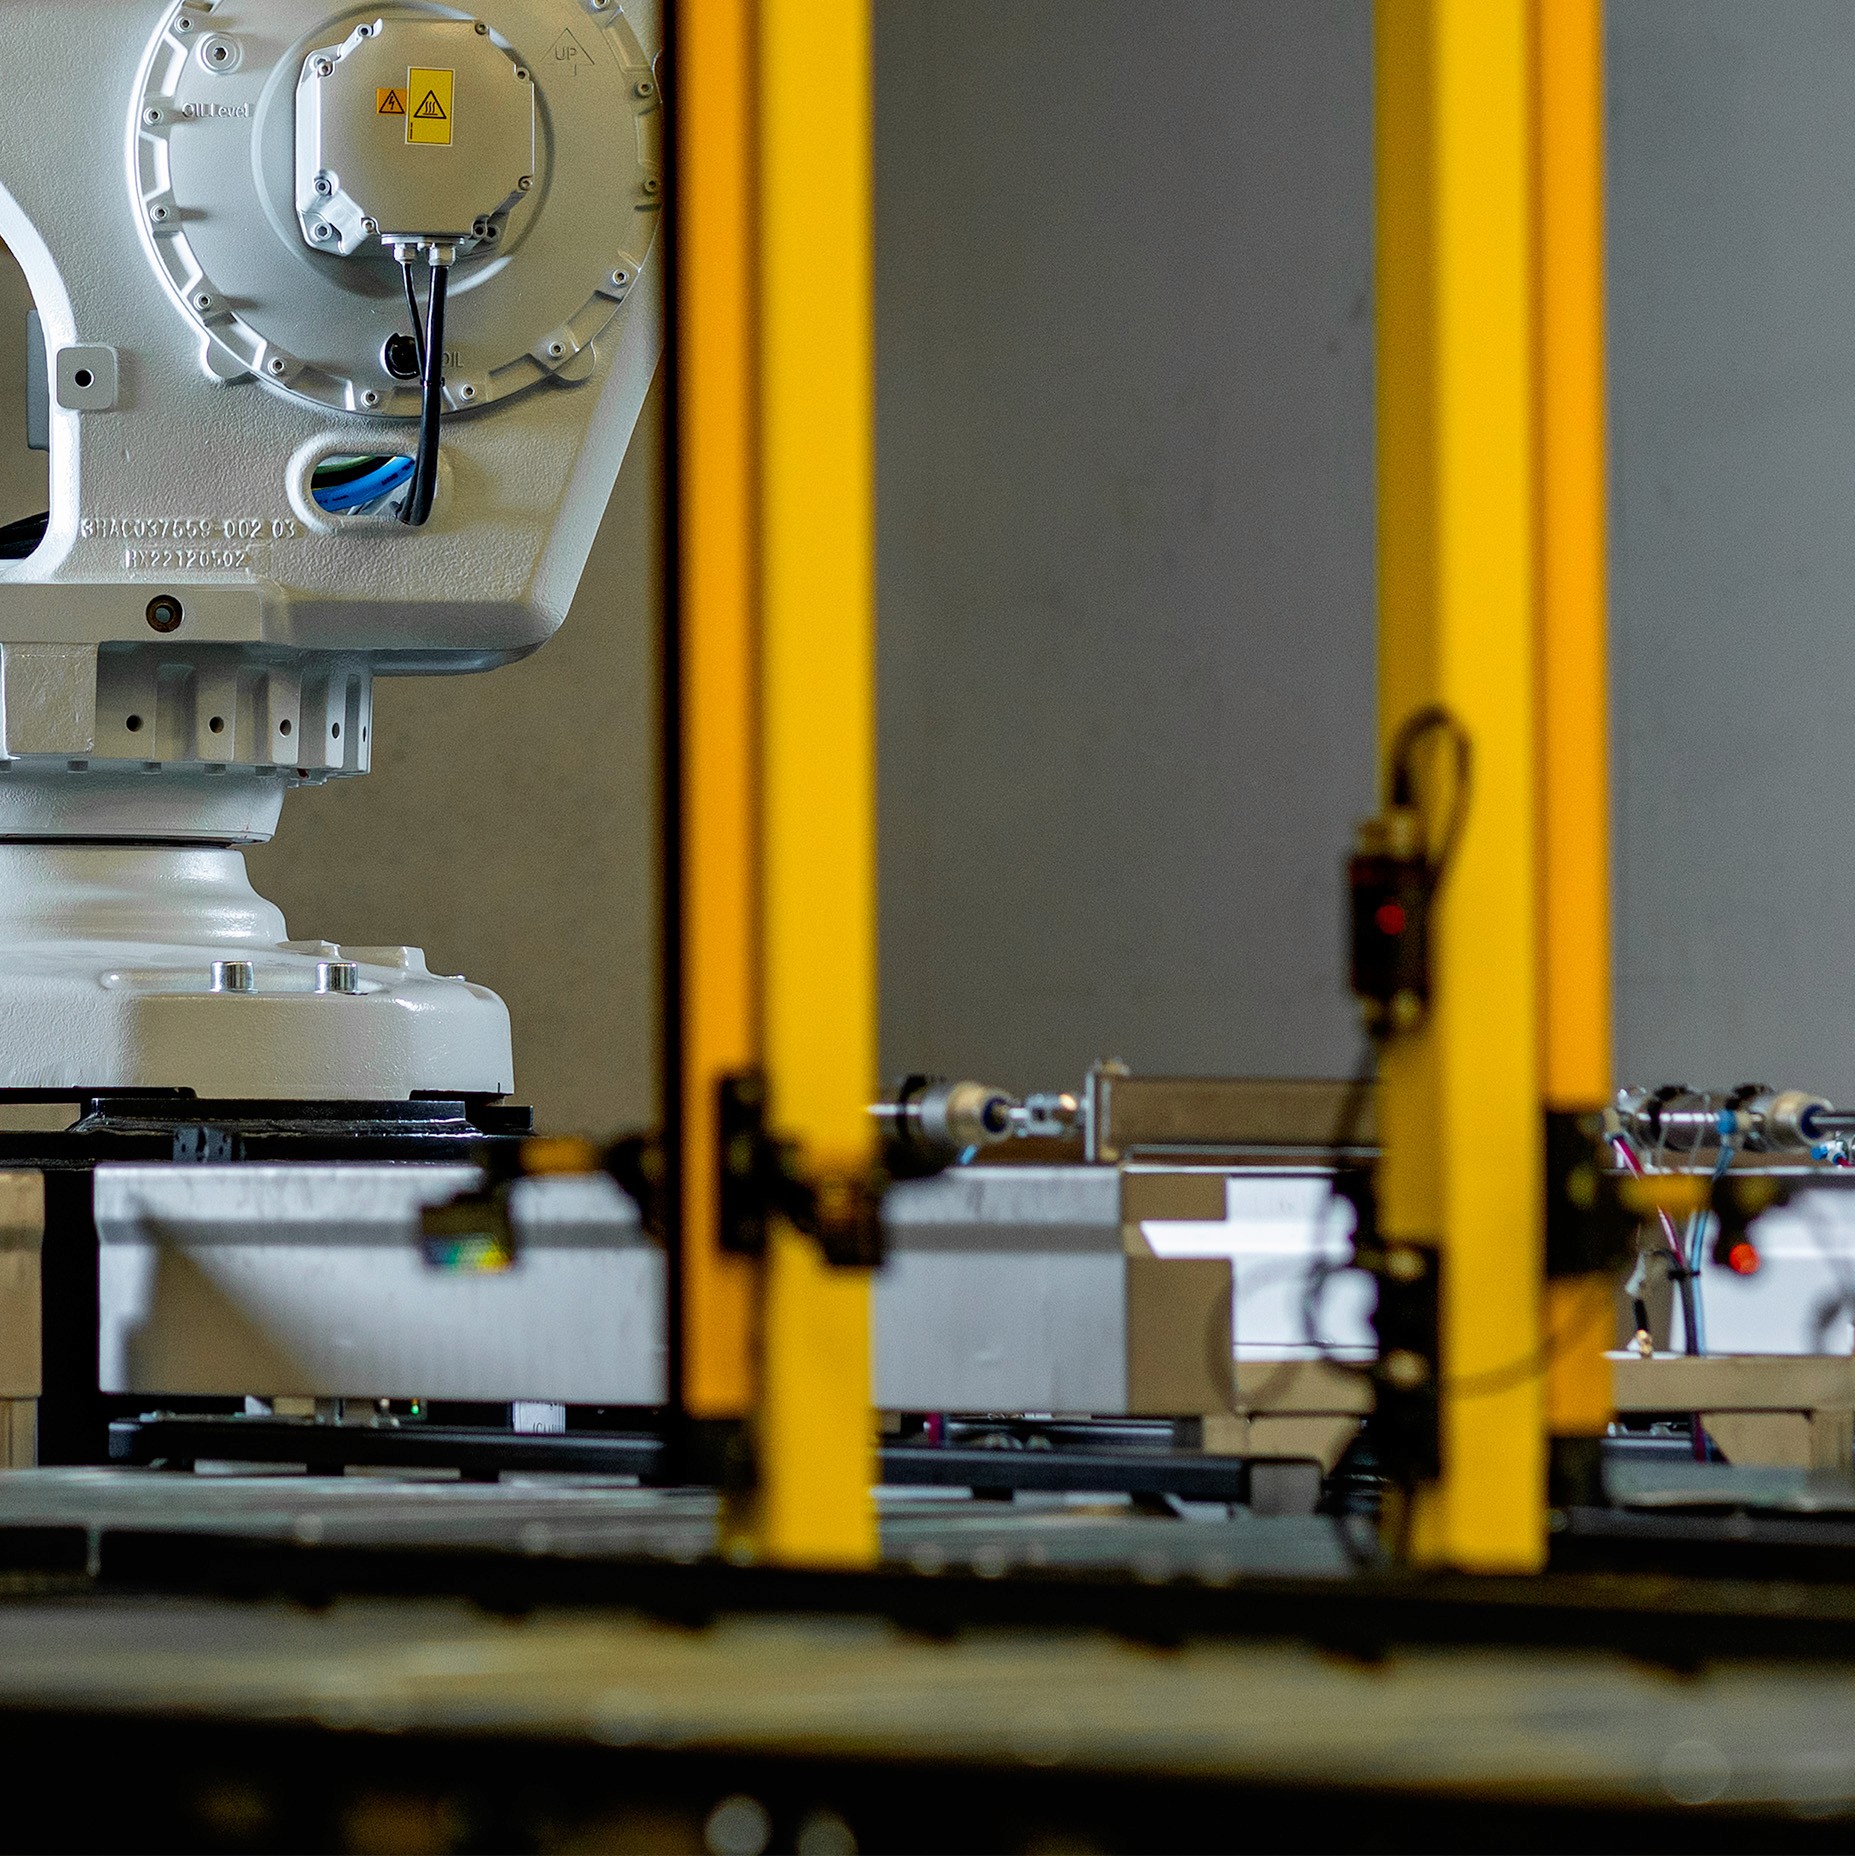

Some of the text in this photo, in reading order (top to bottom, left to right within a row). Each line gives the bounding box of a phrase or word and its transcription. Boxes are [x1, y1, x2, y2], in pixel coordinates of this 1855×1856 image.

[555, 45, 578, 61] UP
[210, 102, 250, 117] Level
[271, 518, 295, 539] 03
